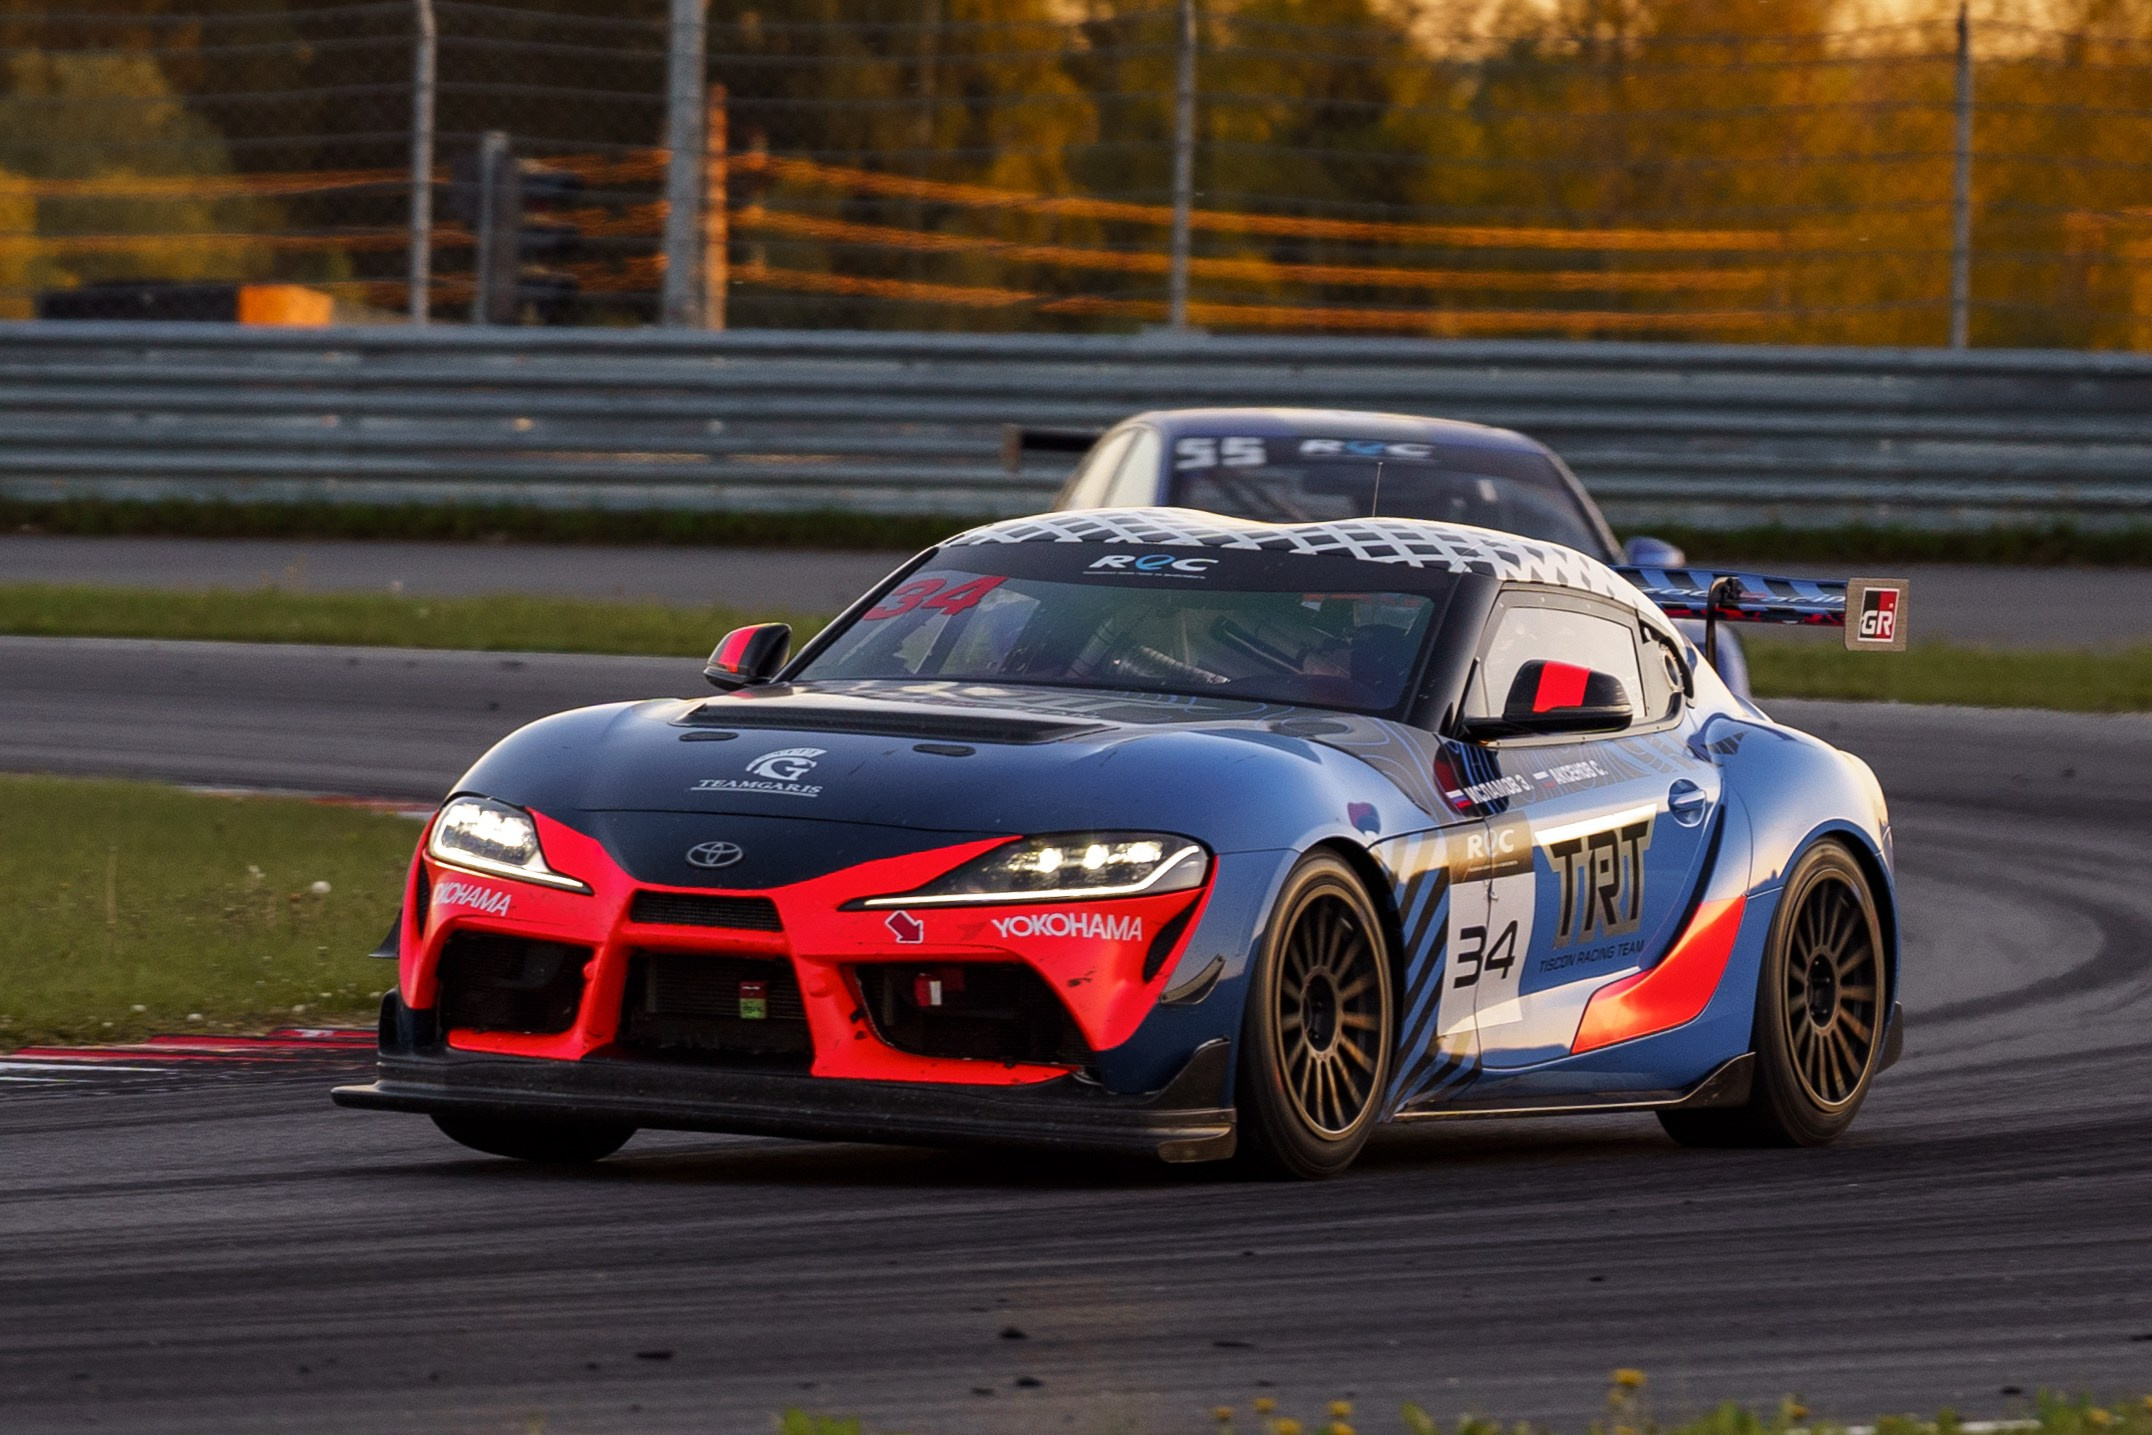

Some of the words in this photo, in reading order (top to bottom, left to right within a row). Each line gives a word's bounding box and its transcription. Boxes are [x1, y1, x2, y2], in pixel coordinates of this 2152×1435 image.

[1176, 437, 1267, 470] 55
[863, 575, 1009, 621] 34
[1861, 609, 1895, 636] GR
[699, 779, 823, 793] TEAMGARIS
[1543, 815, 1653, 942] TRT
[435, 882, 512, 917] OKOHAMA
[991, 912, 1142, 941] YOKOHAMA
[1453, 919, 1519, 989] 34
[1577, 945, 1616, 965] RACING
[1617, 939, 1645, 957] TEAM
